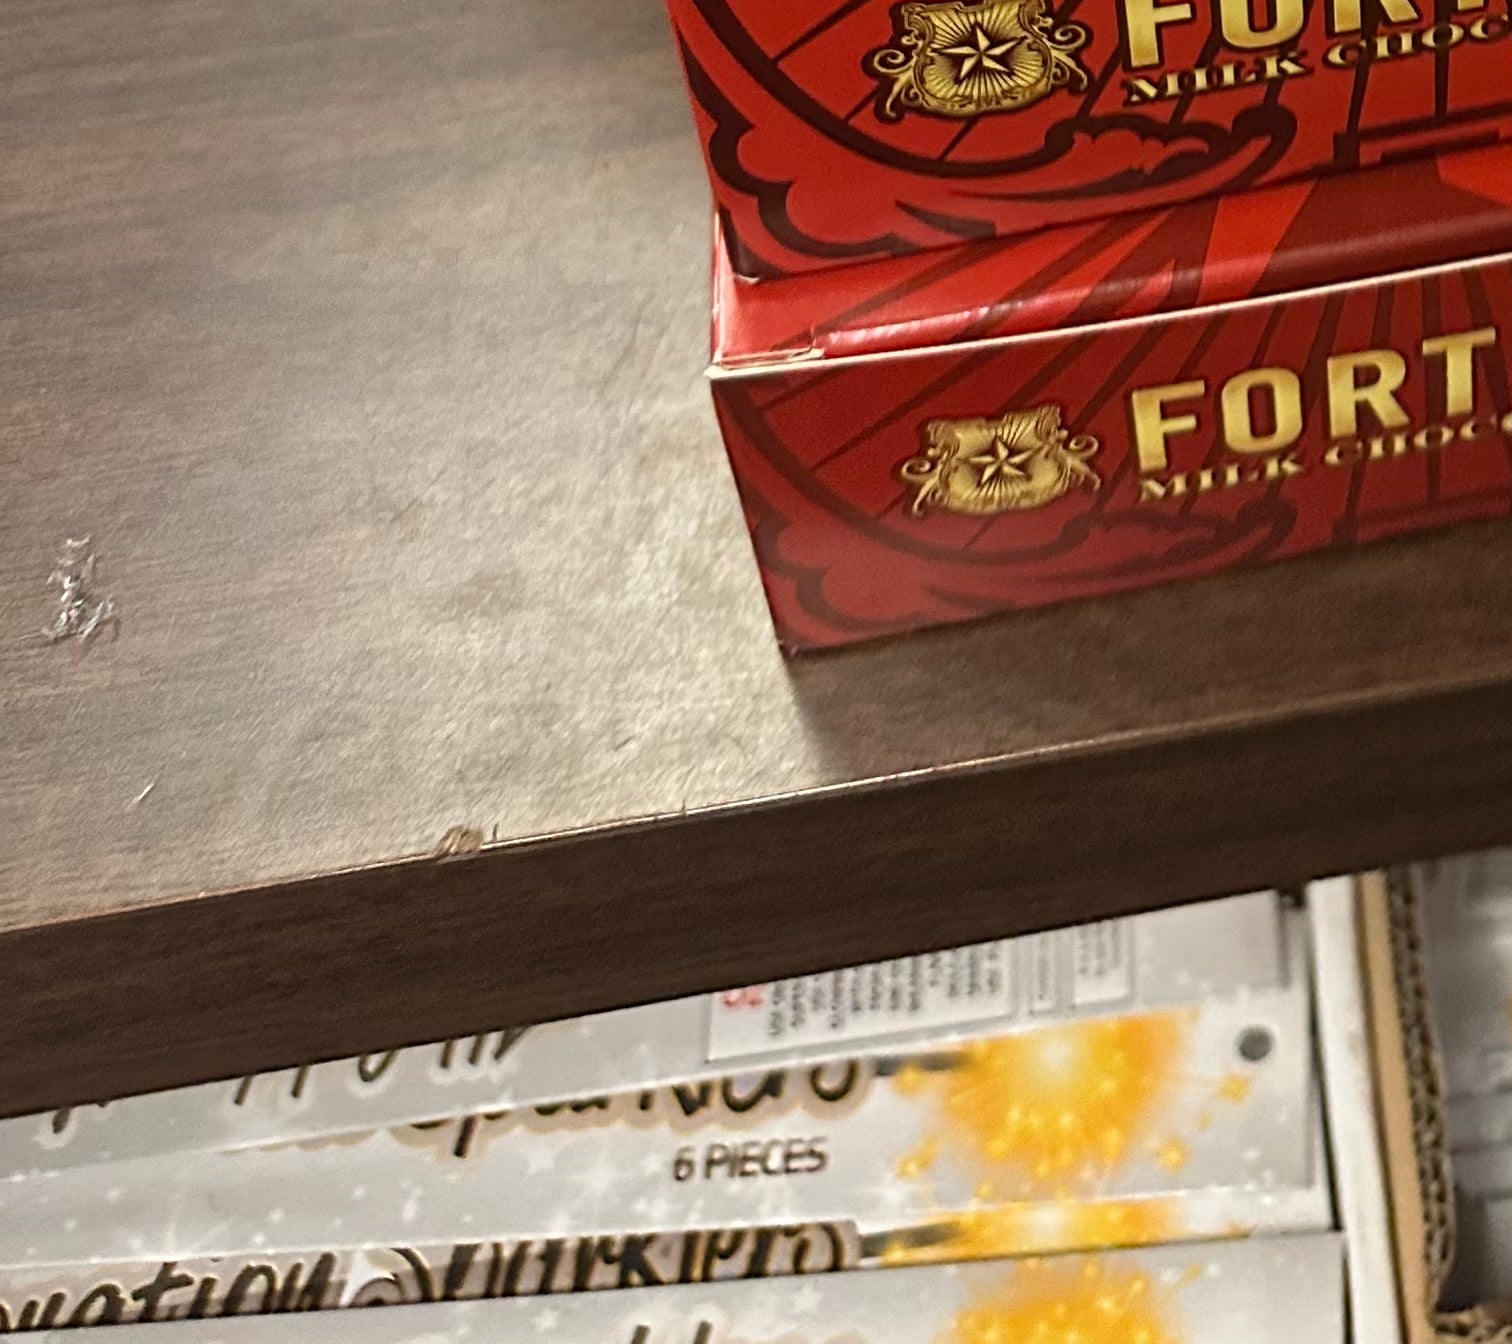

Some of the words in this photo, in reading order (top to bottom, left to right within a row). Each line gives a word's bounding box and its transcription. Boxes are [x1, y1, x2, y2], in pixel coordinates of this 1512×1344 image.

[1123, 38, 1307, 103] MILK
[1129, 324, 1503, 477] FORT
[1137, 450, 1306, 502] MILK
[672, 1143, 695, 1182] 6
[703, 1135, 828, 1179] PIECES
